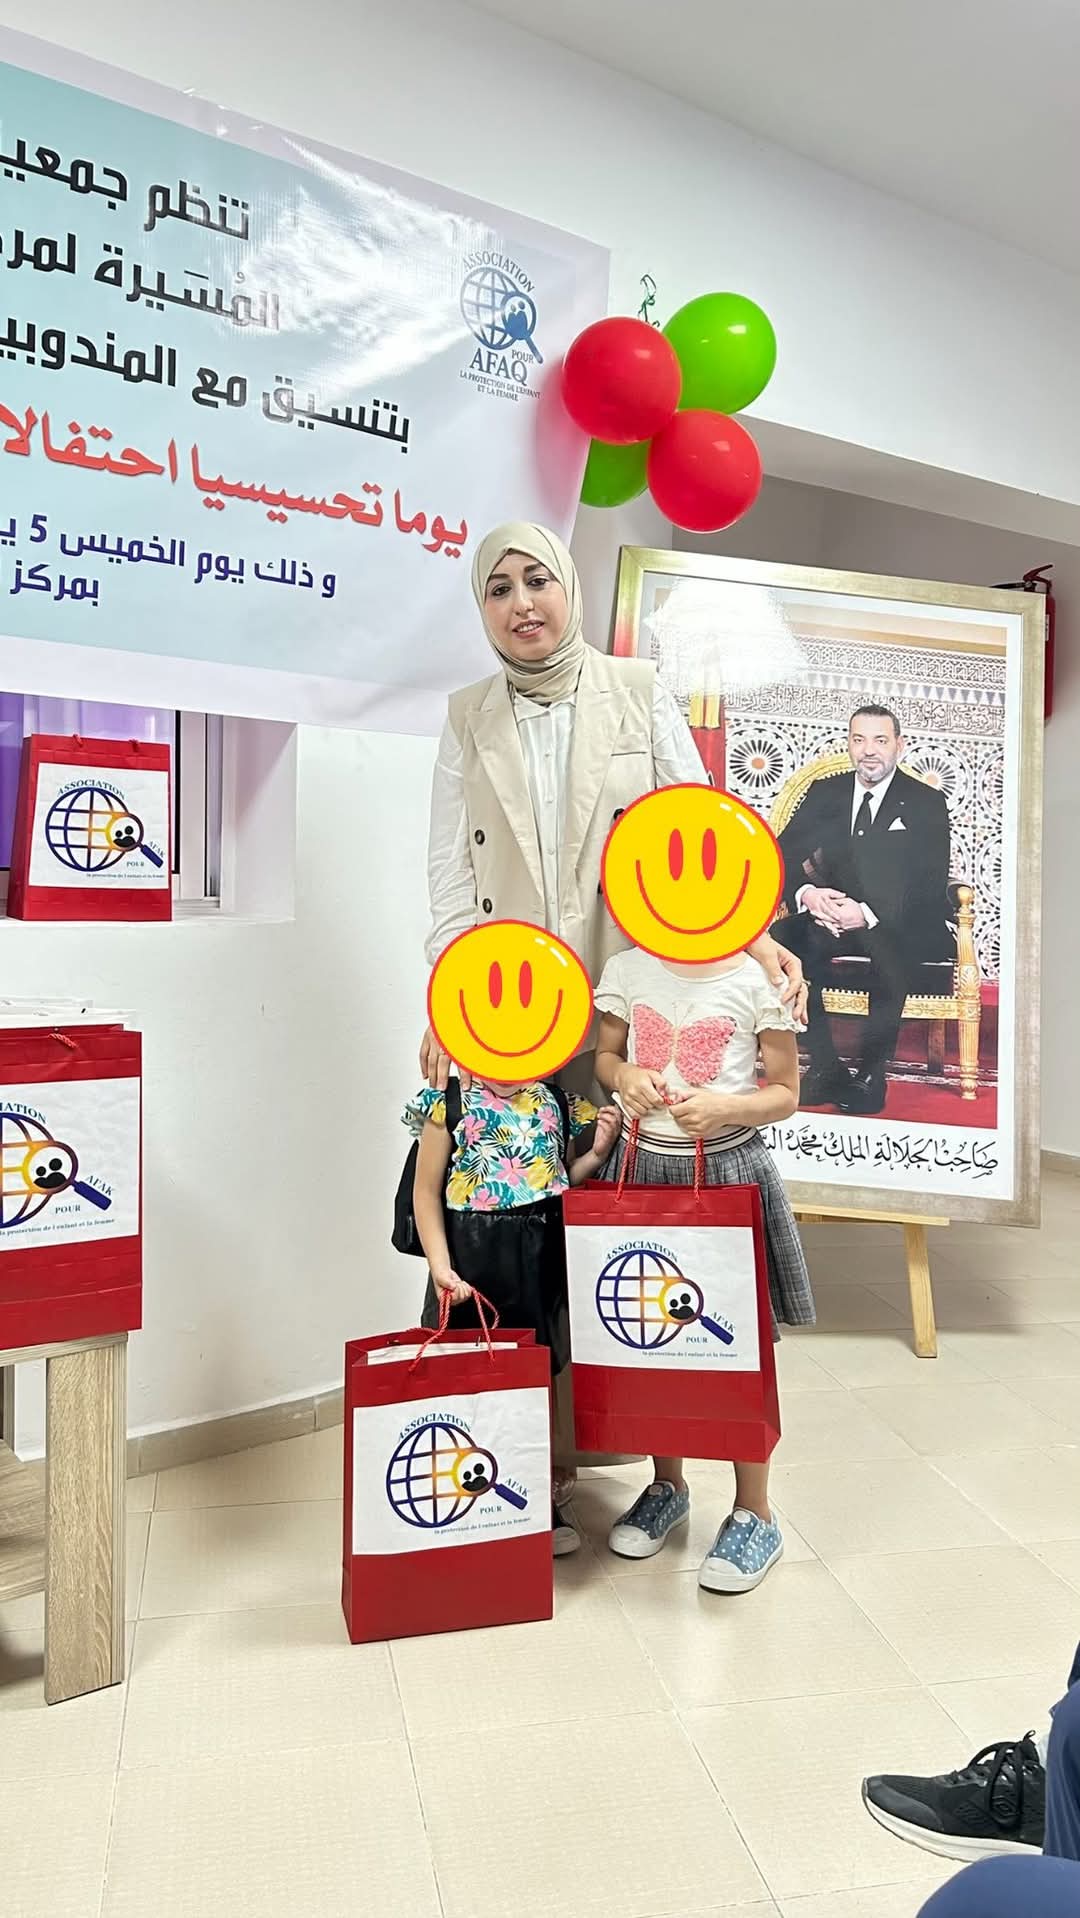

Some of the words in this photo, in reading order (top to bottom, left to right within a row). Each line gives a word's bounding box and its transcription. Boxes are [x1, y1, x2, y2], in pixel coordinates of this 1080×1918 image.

[0, 139, 127, 210] جمعي
[144, 180, 249, 240] تنظم
[0, 229, 76, 275] لمر
[463, 251, 535, 293] ASSOCIATION
[0, 317, 176, 387] المندوبي
[469, 347, 528, 387] AFAQ
[512, 349, 534, 364] POUR
[191, 367, 247, 408] مع
[460, 370, 467, 379] LA
[469, 373, 506, 389] PROTECTION
[477, 384, 485, 393] ET
[487, 387, 495, 395] LA
[496, 389, 519, 401] FEMME
[262, 375, 409, 453] بتنسيق
[191, 443, 383, 527] تحسيسيا
[29, 514, 48, 543] 5
[394, 488, 468, 558] يوما
[60, 533, 185, 567] الخميس
[9, 560, 99, 606] بمركز
[194, 552, 244, 584] يوم
[254, 558, 313, 588] ذلك
[321, 573, 336, 598] و
[57, 779, 125, 800] ASSOCIATION
[55, 1205, 81, 1213] POUR
[605, 1241, 678, 1262] ASSOCIATION
[398, 1413, 472, 1442] ASSOCIATION
[480, 1506, 502, 1514] POUR
